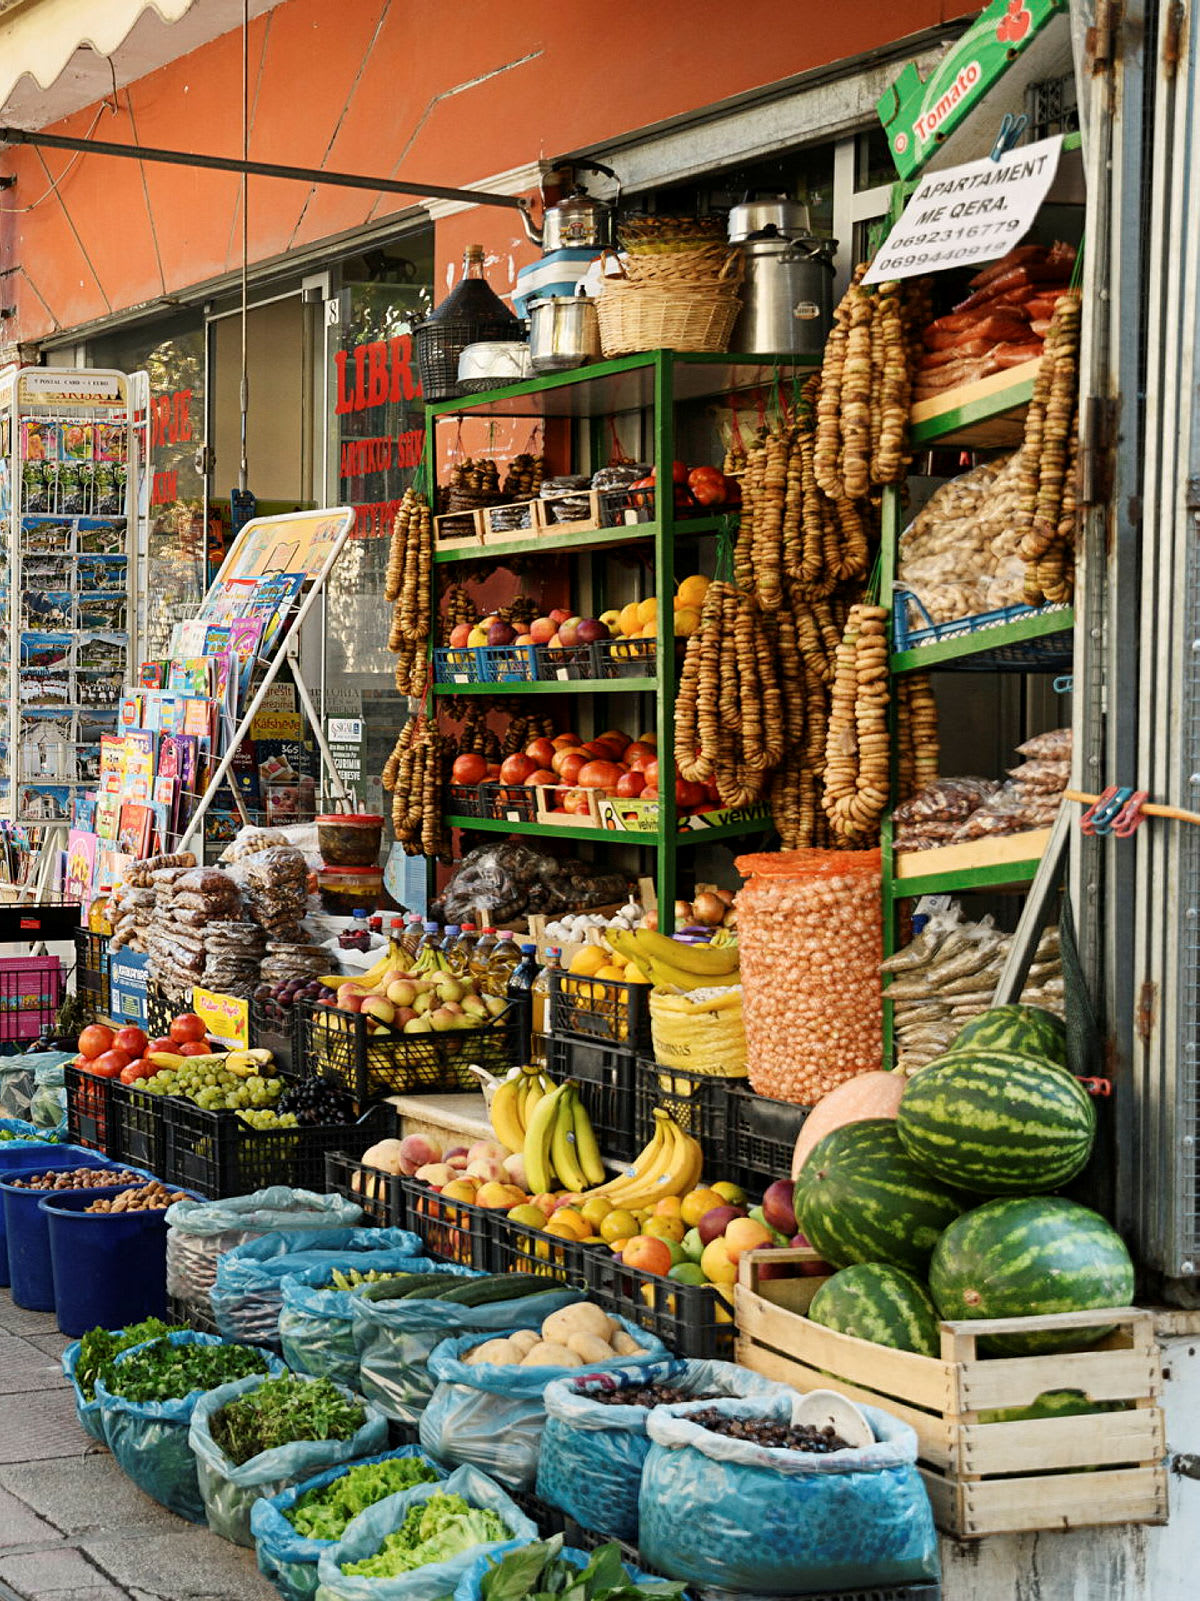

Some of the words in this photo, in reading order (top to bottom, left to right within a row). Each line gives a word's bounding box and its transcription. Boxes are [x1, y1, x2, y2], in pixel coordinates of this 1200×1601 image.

[913, 65, 979, 141] Tomato
[916, 154, 1049, 202] APARTAMENT
[915, 204, 945, 227] ME
[949, 196, 1008, 221] QERA.
[891, 219, 1020, 250] 0692316779
[147, 387, 193, 448] OPJE
[397, 429, 427, 469] SHK
[281, 743, 299, 754] 365
